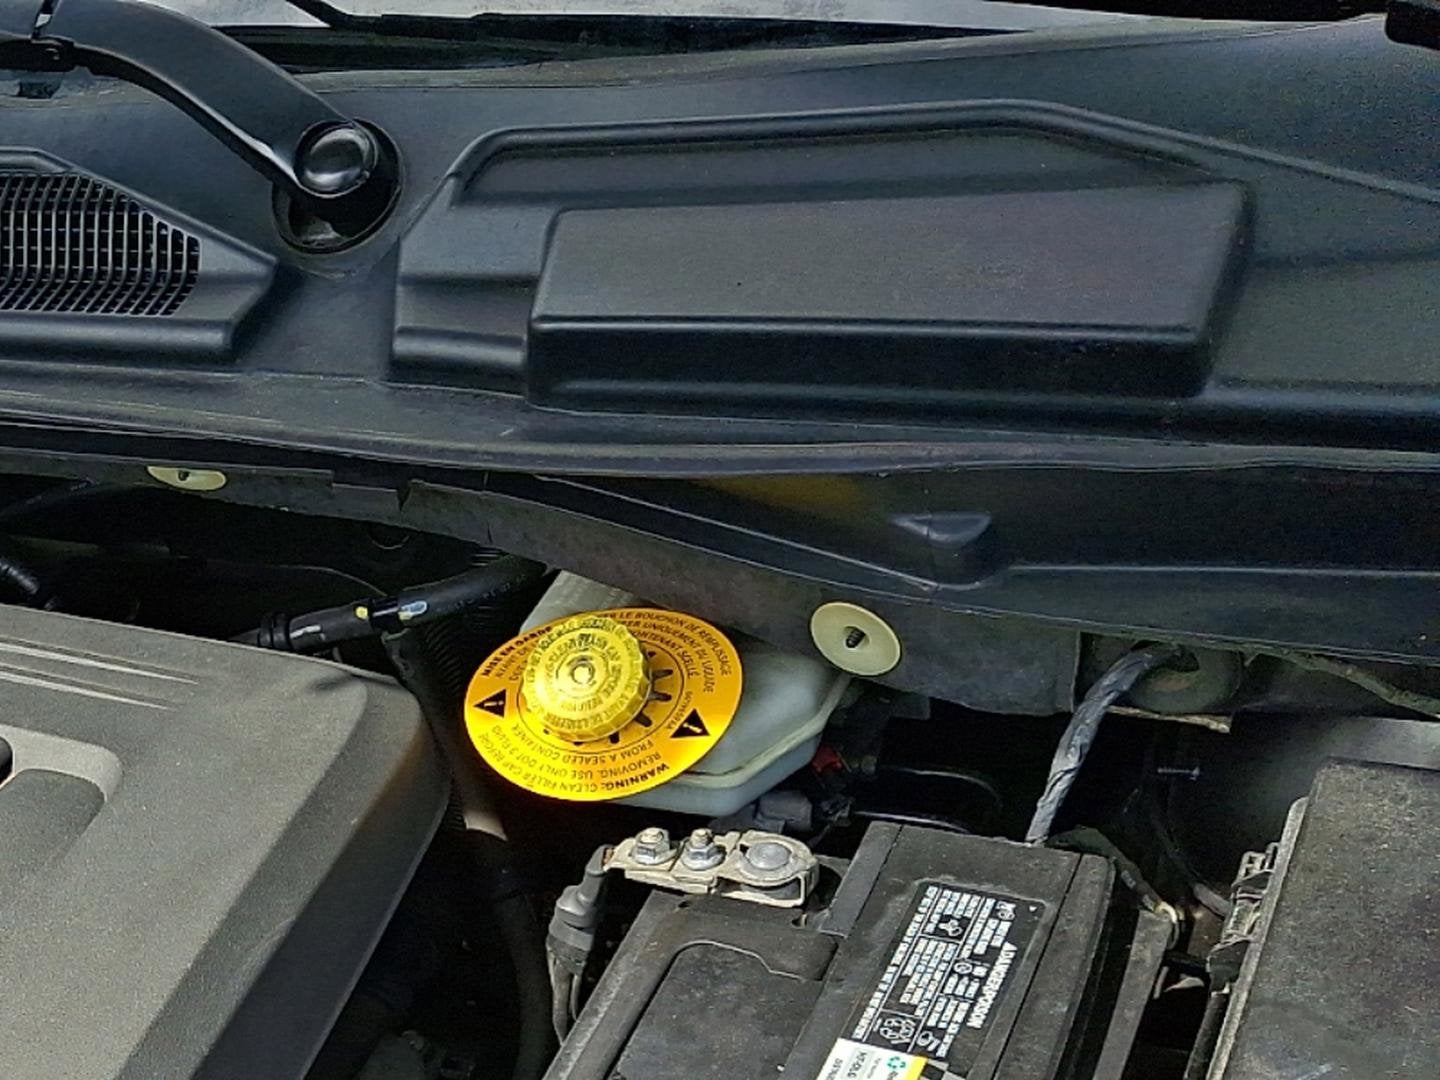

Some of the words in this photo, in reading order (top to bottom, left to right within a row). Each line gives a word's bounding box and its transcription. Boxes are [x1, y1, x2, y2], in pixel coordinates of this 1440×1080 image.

[635, 630, 682, 652] ONTENANT
[571, 770, 593, 780] USE
[601, 763, 670, 792] WARNING:
